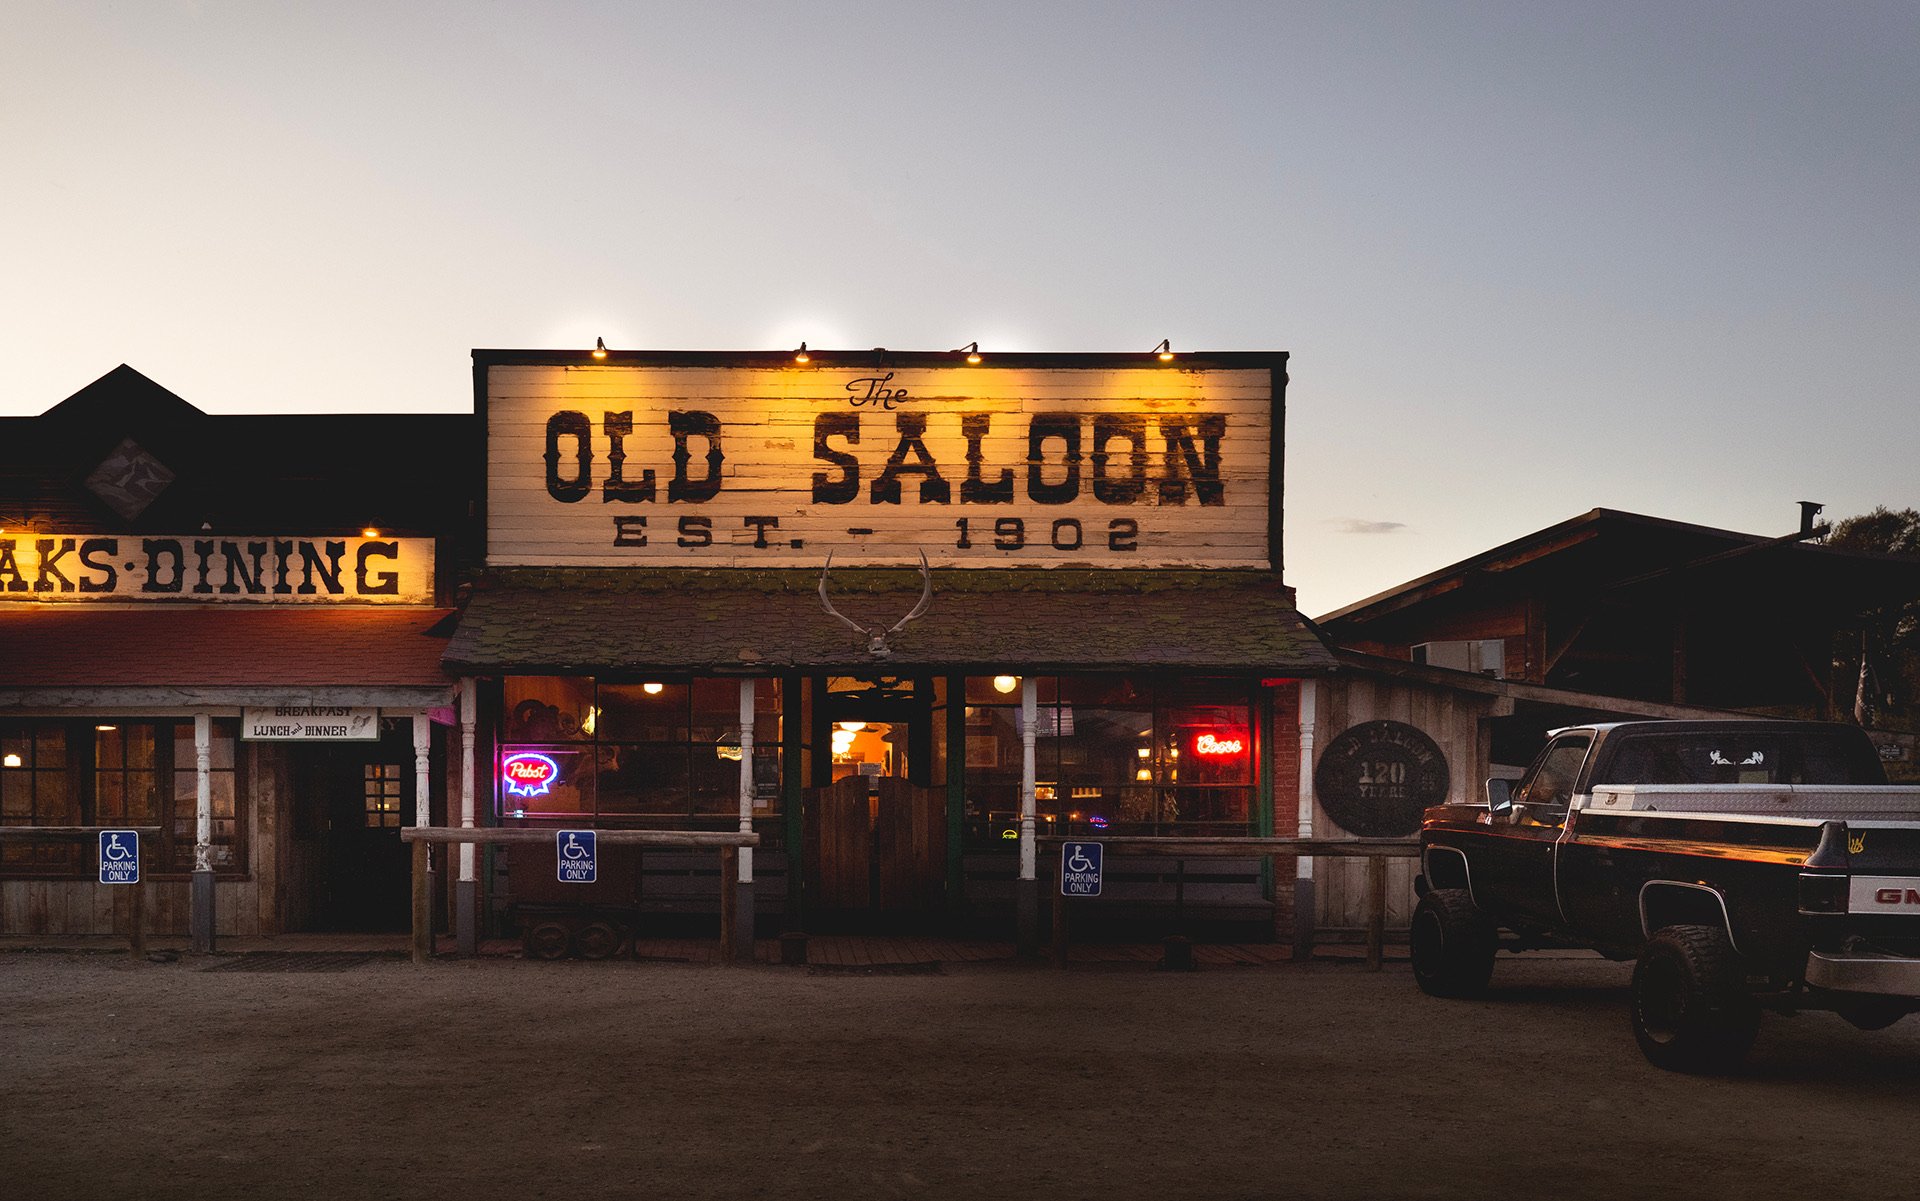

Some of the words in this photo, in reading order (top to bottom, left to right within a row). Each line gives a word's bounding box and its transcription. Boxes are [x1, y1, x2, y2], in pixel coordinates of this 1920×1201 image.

[845, 372, 908, 410] The
[543, 410, 726, 504] OLD
[812, 411, 1226, 506] SALOON
[613, 516, 803, 549] EST.
[956, 517, 1138, 551] 1902
[142, 538, 399, 595] DINING
[253, 725, 291, 737] LUNCH
[290, 722, 303, 736] and
[305, 725, 347, 737] DINNER
[1196, 734, 1243, 754] Coors
[510, 761, 549, 779] Pabst
[1358, 761, 1406, 784] 120
[102, 861, 136, 871] PARKING
[560, 860, 594, 870] PARKING
[108, 870, 131, 881] ONLY
[566, 869, 588, 880] ONLY
[1064, 872, 1099, 883] PARKING
[1070, 882, 1092, 893] ONLY
